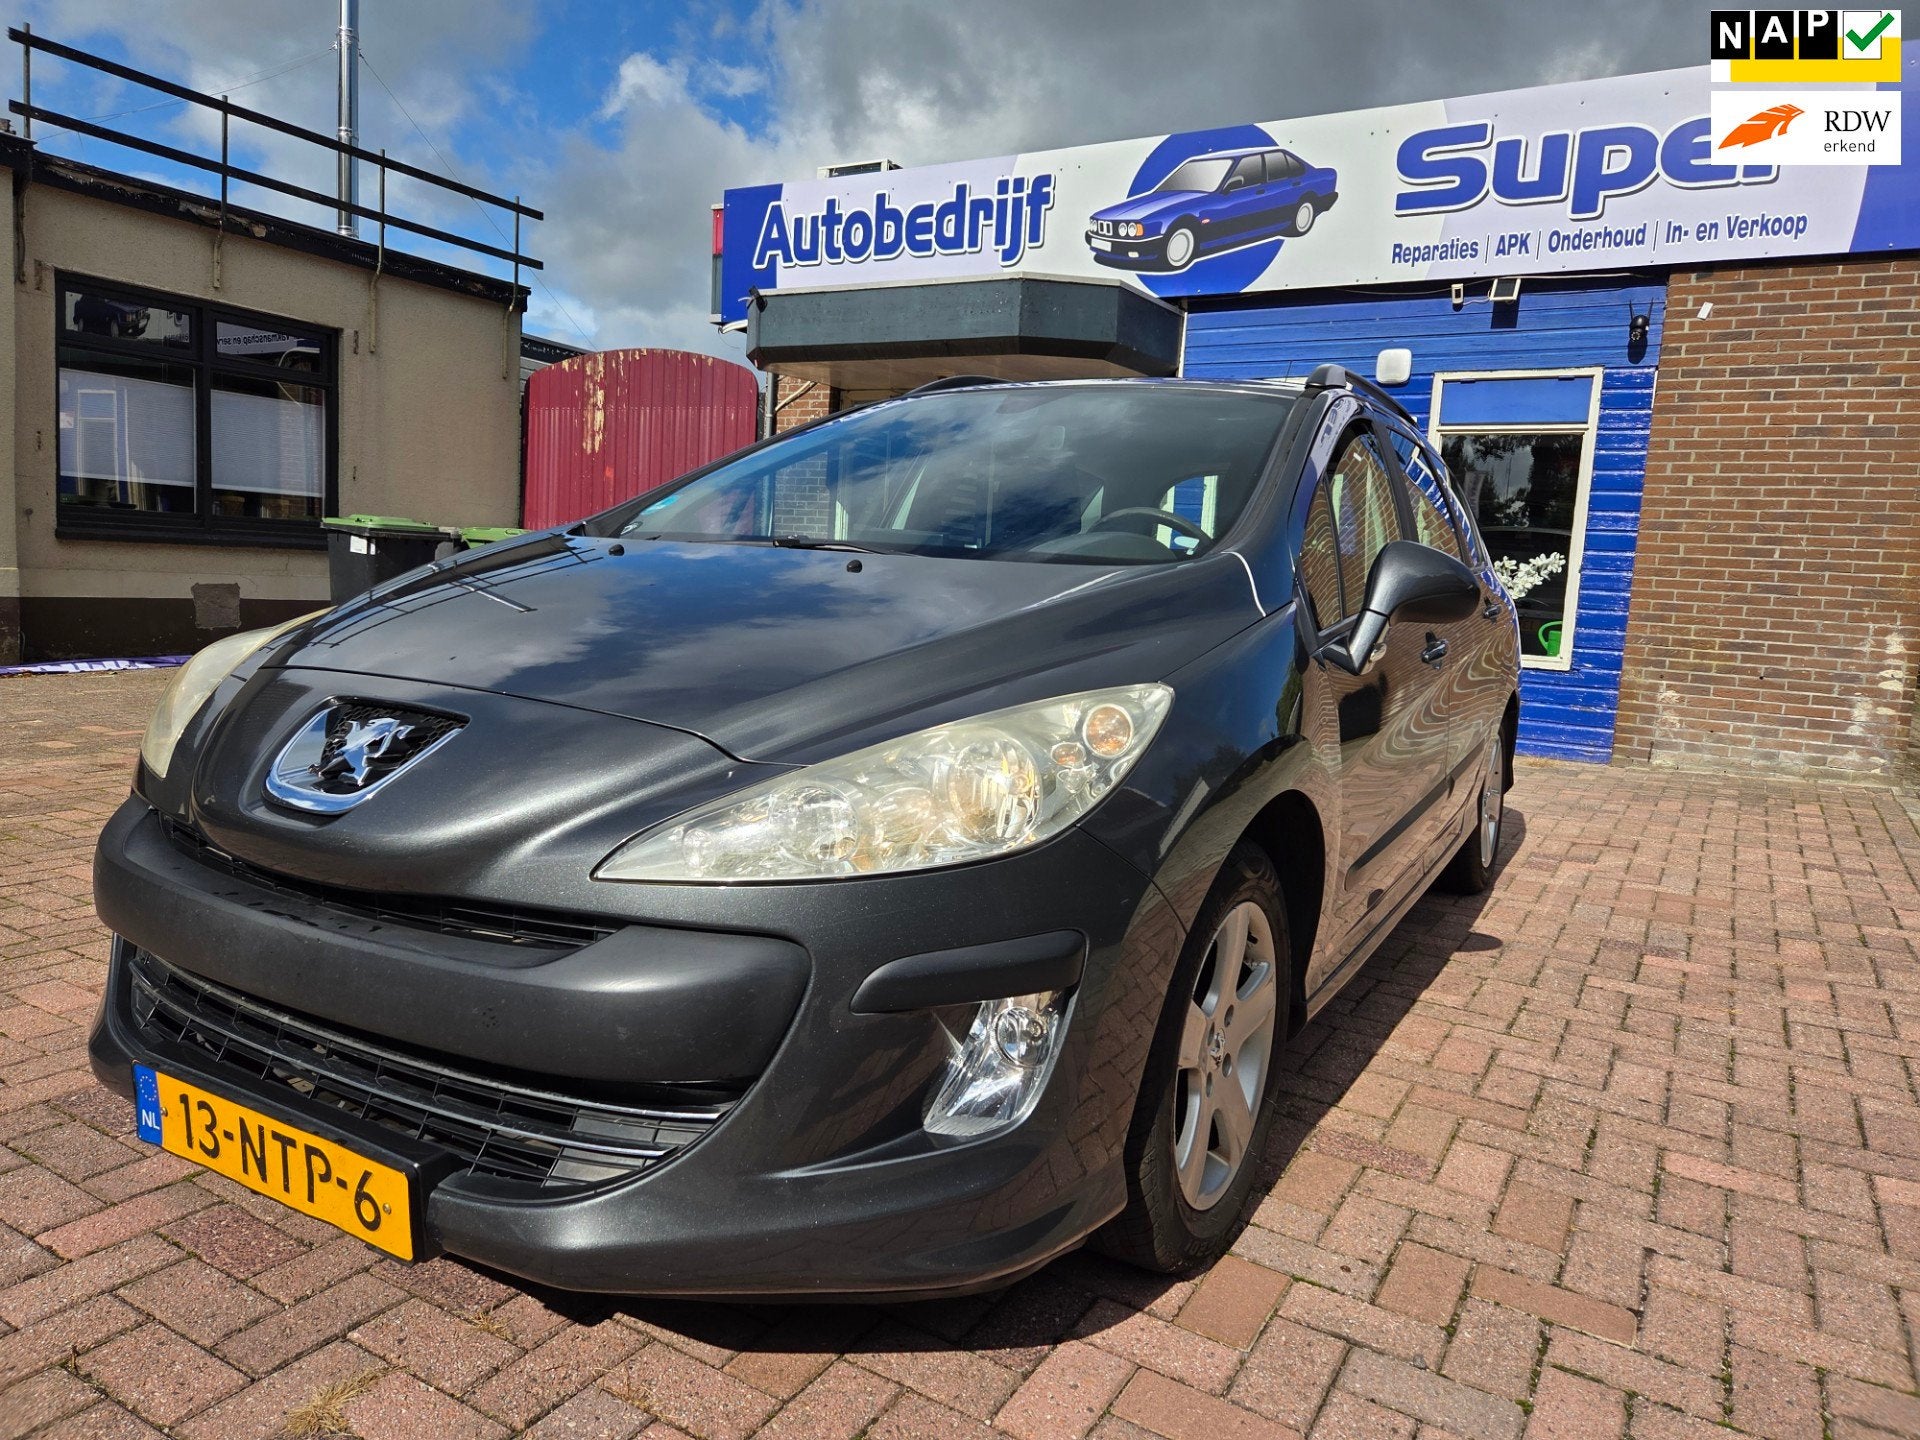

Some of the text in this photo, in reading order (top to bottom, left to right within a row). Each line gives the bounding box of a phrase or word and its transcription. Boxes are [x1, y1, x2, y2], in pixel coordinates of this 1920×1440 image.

[753, 114, 1780, 269] Autobedrijf Supe
[1391, 213, 1808, 267] Reparaties APK Onderhoud In- en Verkoop
[141, 1109, 160, 1131] NL
[179, 1093, 382, 1232] 13-NTP-6
